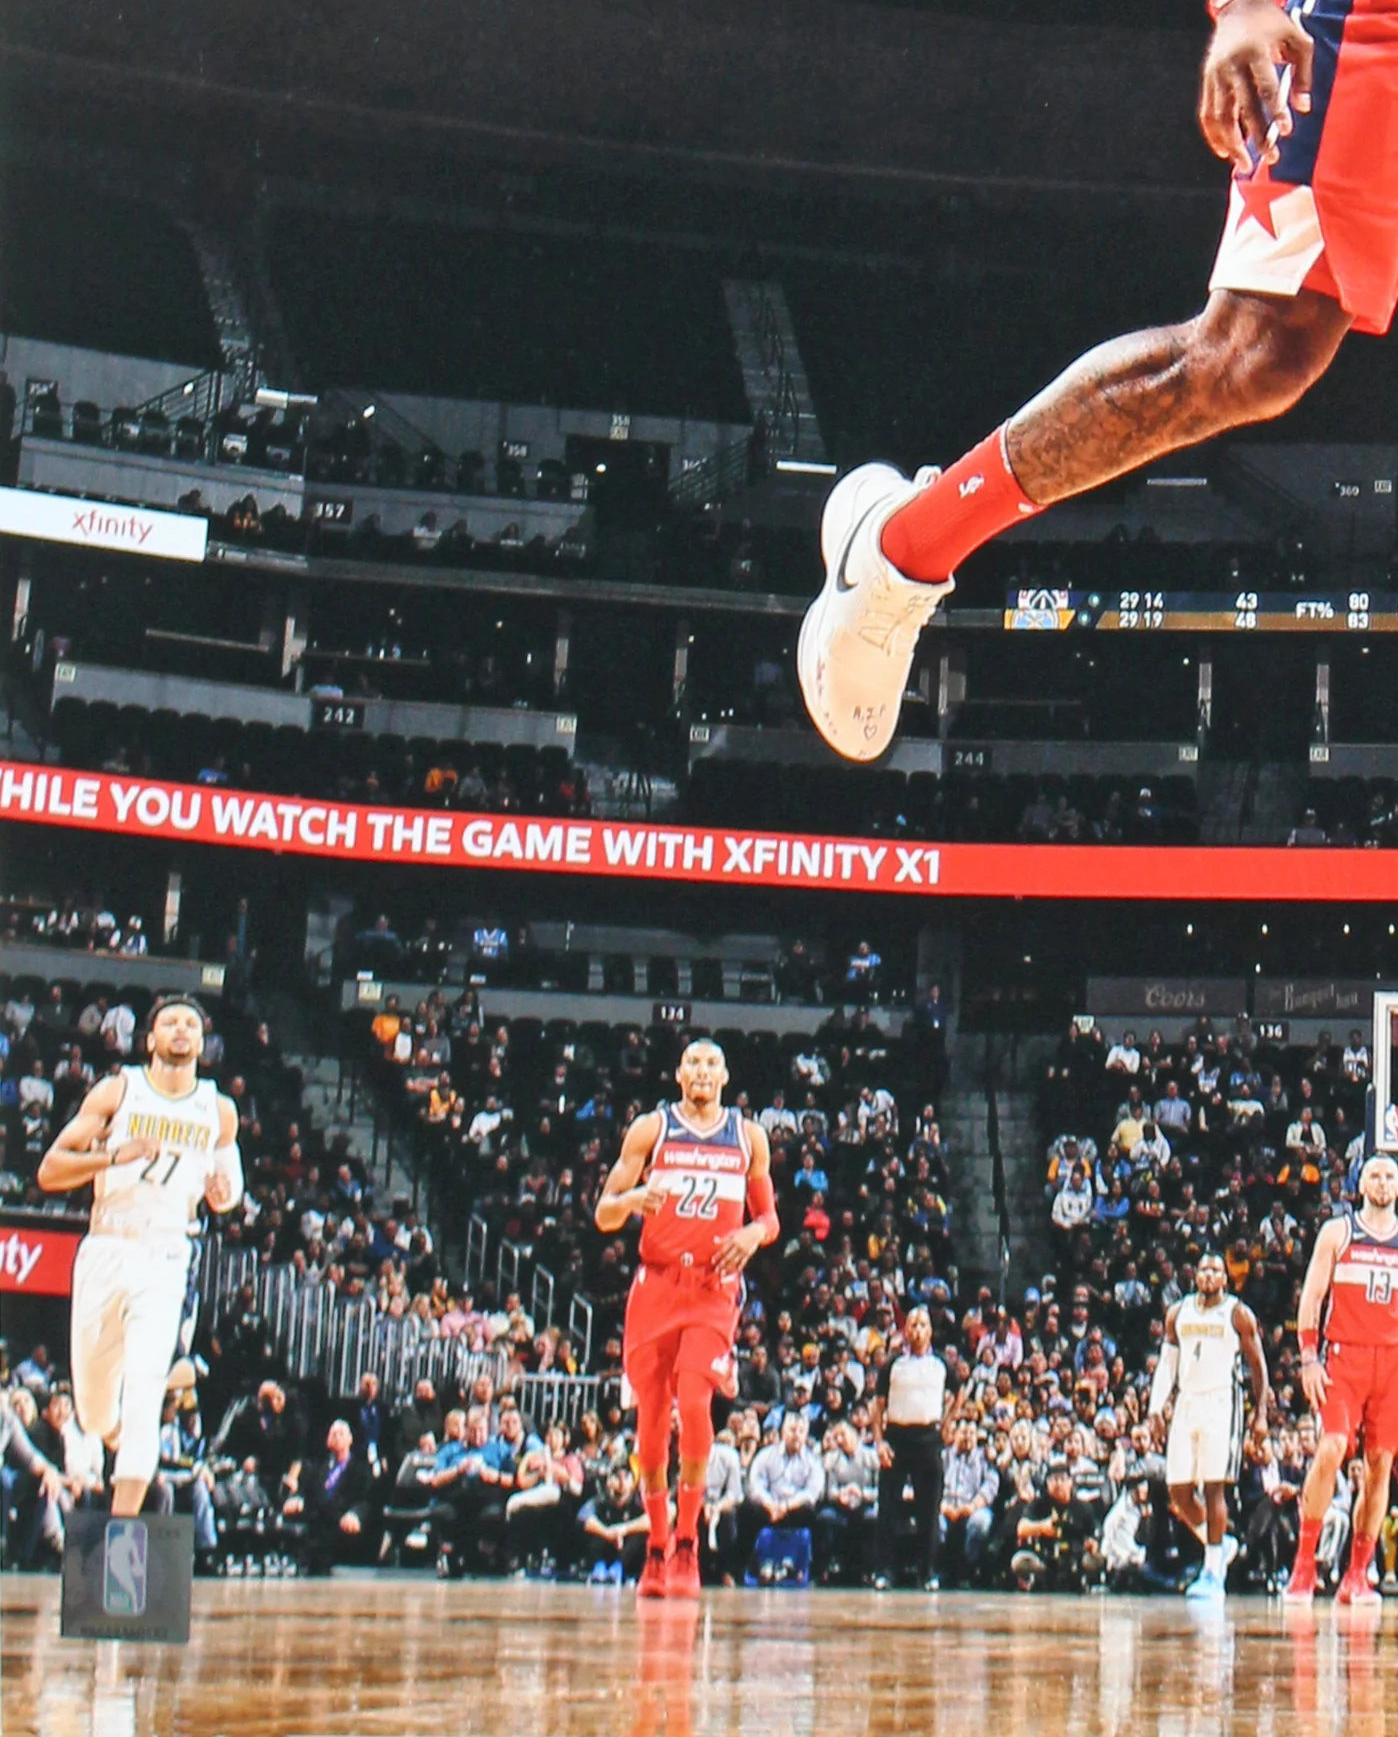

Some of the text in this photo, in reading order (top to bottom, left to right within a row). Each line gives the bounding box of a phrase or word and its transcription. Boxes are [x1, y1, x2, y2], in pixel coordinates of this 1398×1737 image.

[72, 509, 154, 545] xfinity
[1120, 591, 1164, 609] 29 14
[1235, 591, 1258, 609] 43
[1295, 601, 1334, 620] FT%
[1119, 612, 1139, 629] 29
[1235, 612, 1257, 629] 48
[324, 707, 355, 724] 242
[955, 750, 985, 766] 244
[109, 781, 201, 831] YOU
[211, 794, 358, 849] WATCH
[367, 813, 452, 855] THE
[461, 820, 593, 865] GAME
[602, 828, 714, 871] WITH
[722, 835, 888, 883] XFINITY
[895, 846, 941, 886] X1
[1259, 1024, 1283, 1038] 136
[139, 1147, 182, 1186] 27
[675, 1174, 718, 1218] 22
[1366, 1269, 1391, 1305] 13
